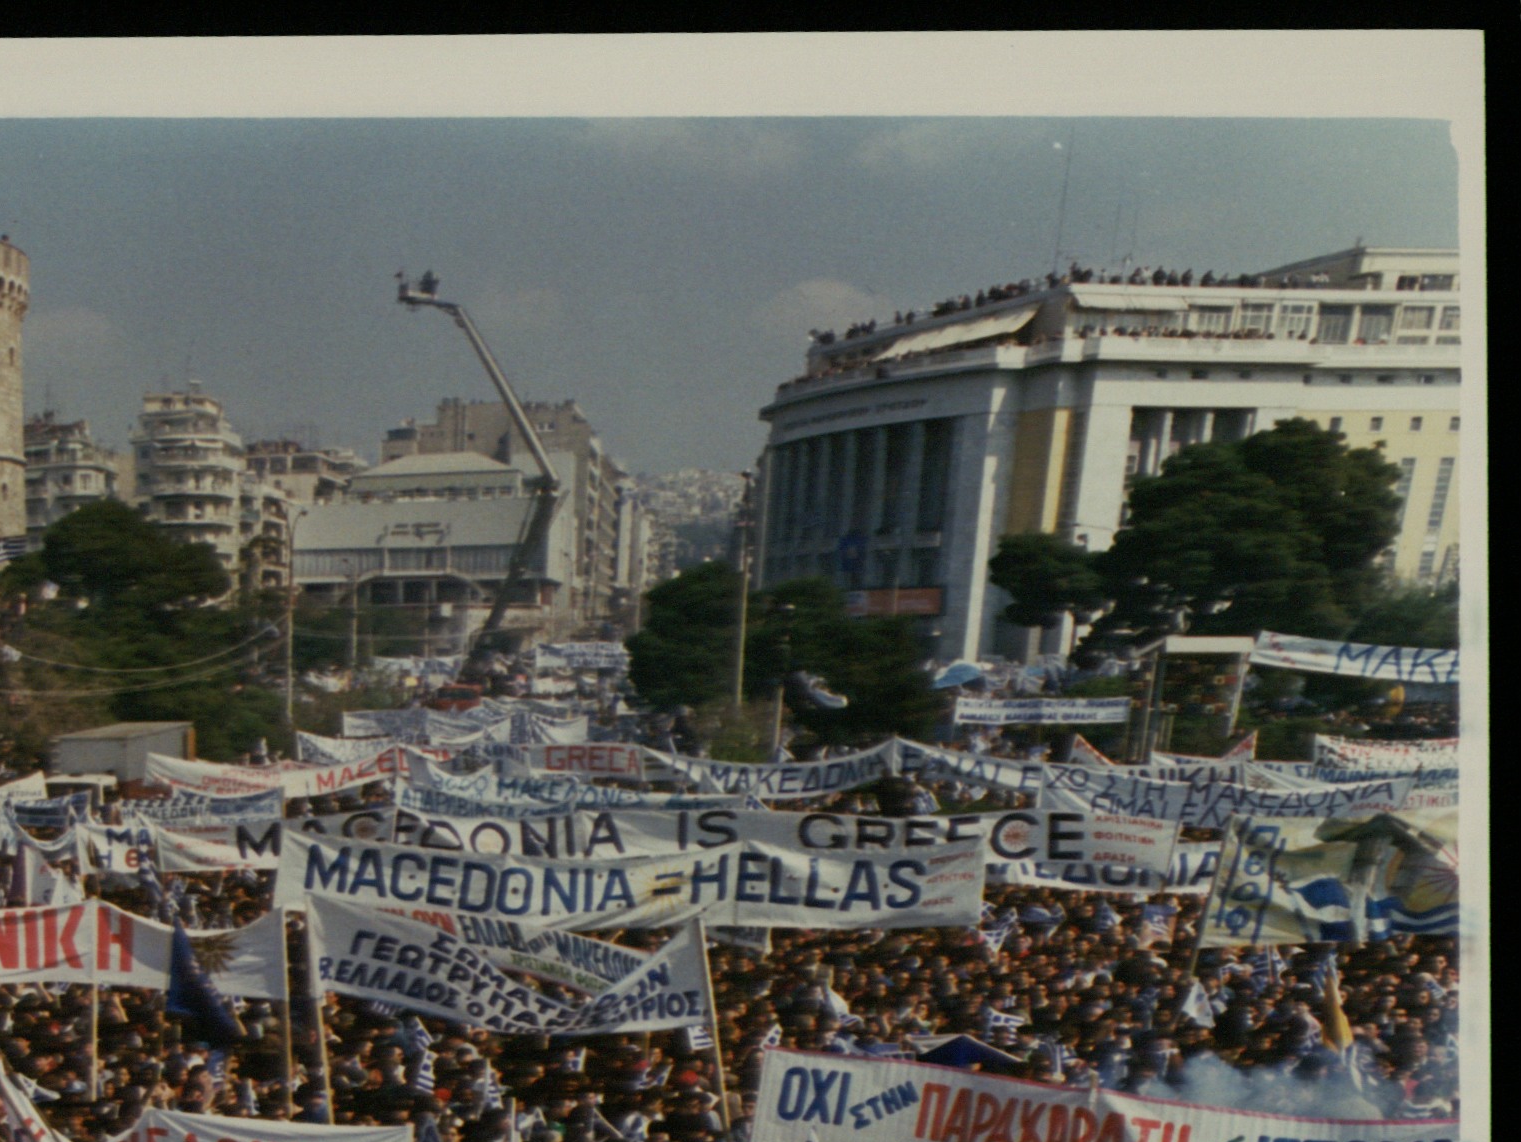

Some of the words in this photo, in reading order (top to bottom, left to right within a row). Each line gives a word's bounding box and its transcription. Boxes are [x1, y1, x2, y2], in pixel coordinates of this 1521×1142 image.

[544, 744, 642, 774] GRECA
[678, 811, 738, 851] IS
[798, 812, 1085, 863] GREECE
[304, 844, 636, 916] MACEDONIA
[778, 1066, 853, 1126] ΟΧΙ
[849, 1081, 917, 1130] ΣΤΗΝ
